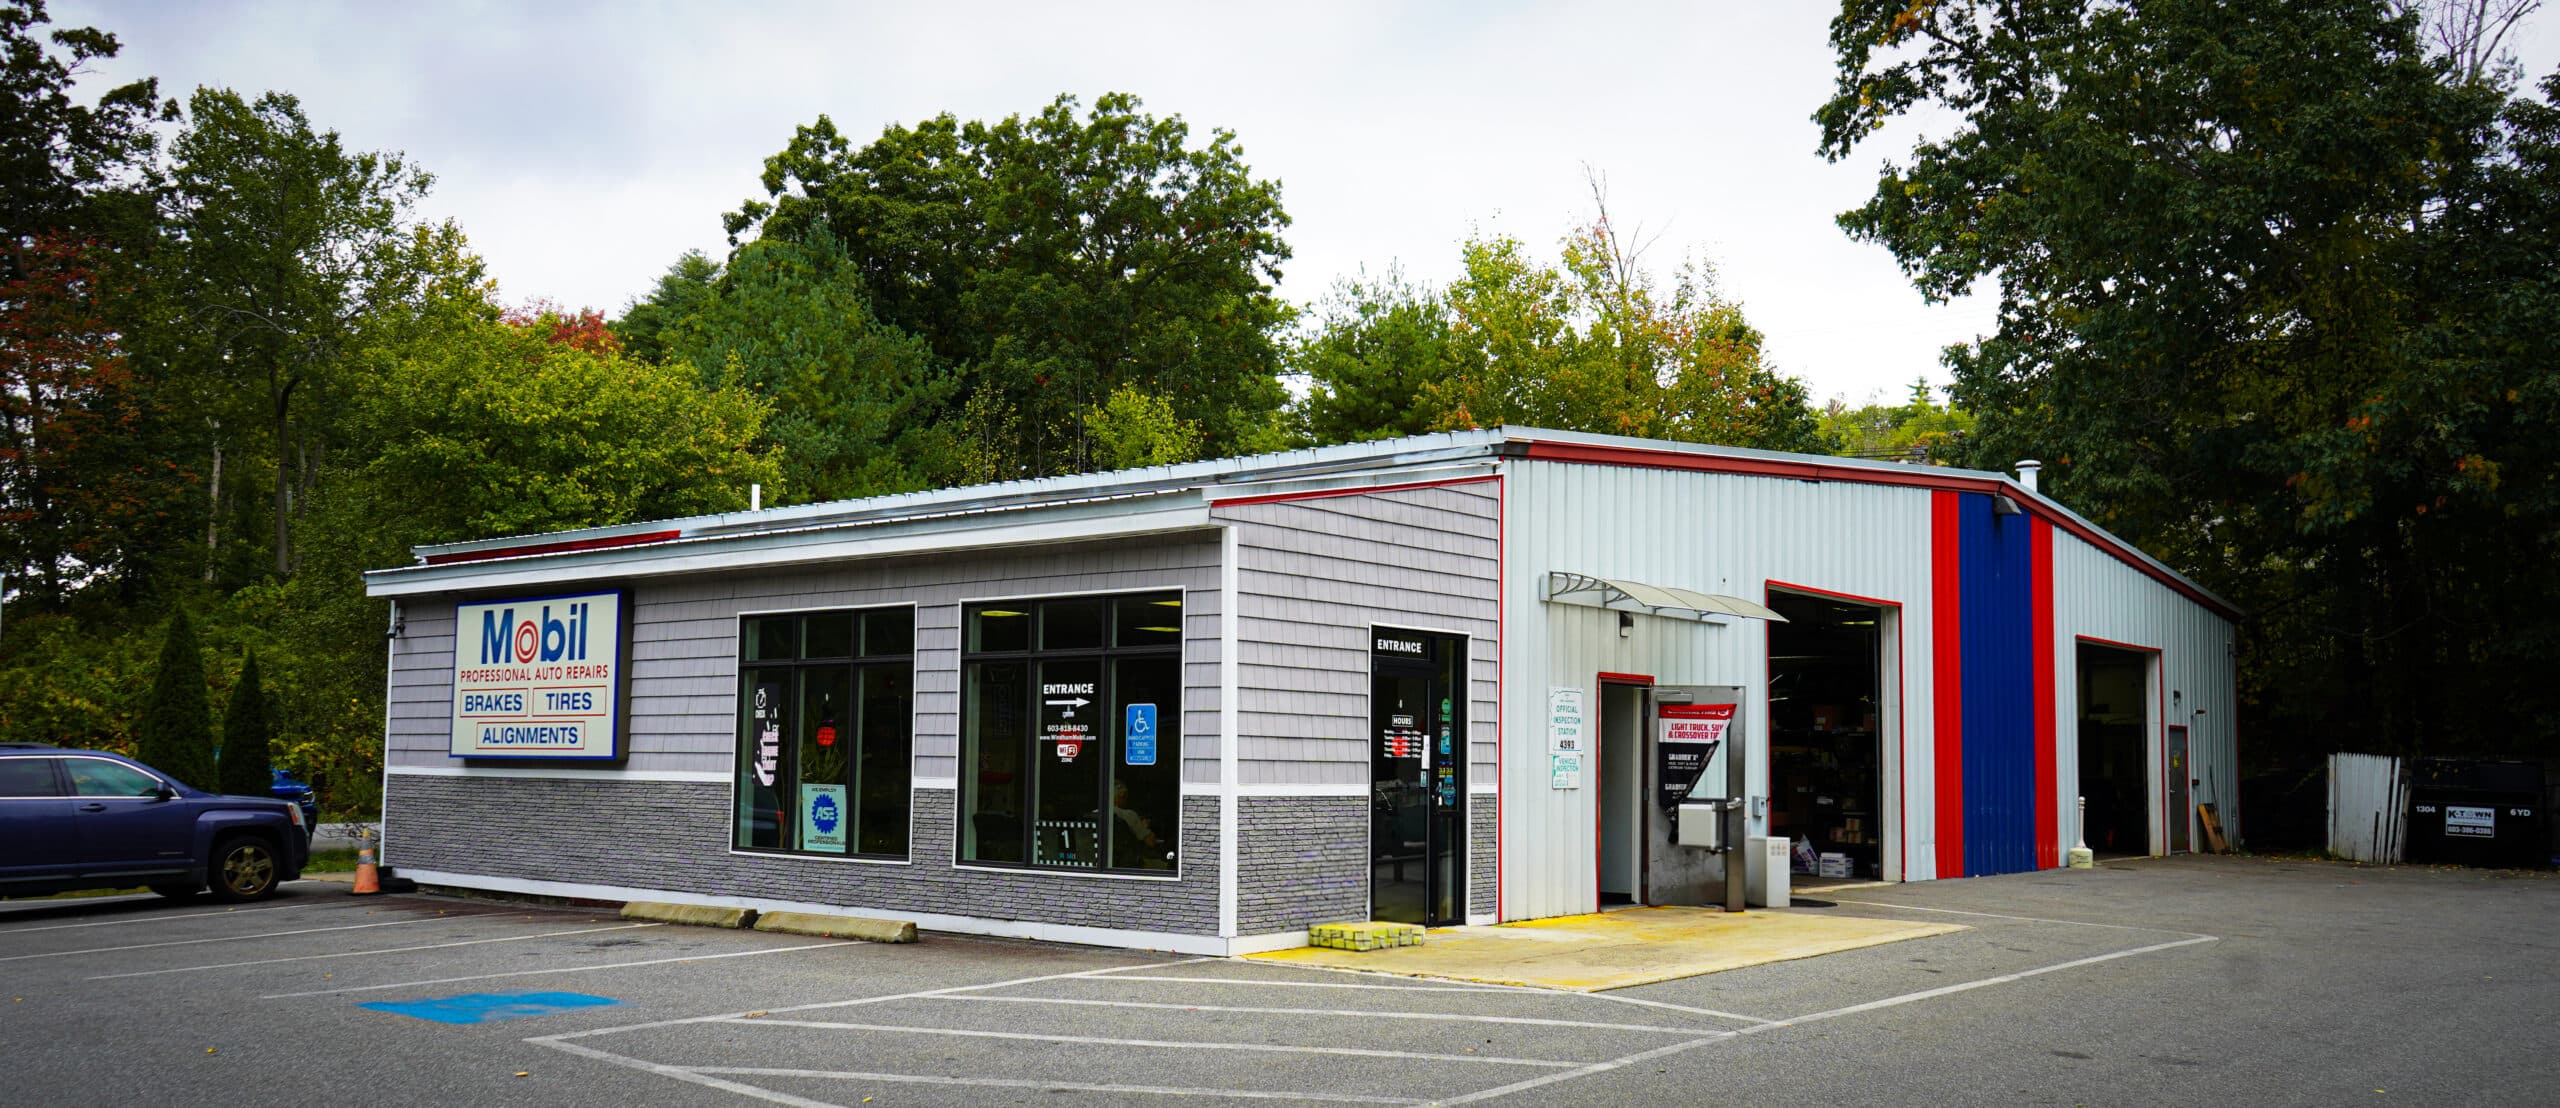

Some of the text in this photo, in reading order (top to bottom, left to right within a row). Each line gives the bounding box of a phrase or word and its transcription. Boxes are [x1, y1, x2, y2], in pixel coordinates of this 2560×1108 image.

[481, 603, 588, 665] Mobil
[1377, 638, 1422, 654] ENTRANCE
[460, 664, 608, 683] PROFESSIONAL AUTO REPAIRS
[1043, 683, 1094, 695] ENTRANCE
[465, 692, 592, 712] BRAKES TIRES
[1556, 705, 1577, 713] OFFICIAL
[1558, 727, 1576, 735] STATION
[1671, 723, 1688, 731] LIGHT
[482, 727, 579, 744] ALIGNMENTS
[1674, 731, 1710, 740] CROSSOVER
[1560, 740, 1574, 749] 4393
[815, 806, 835, 821] ASE
